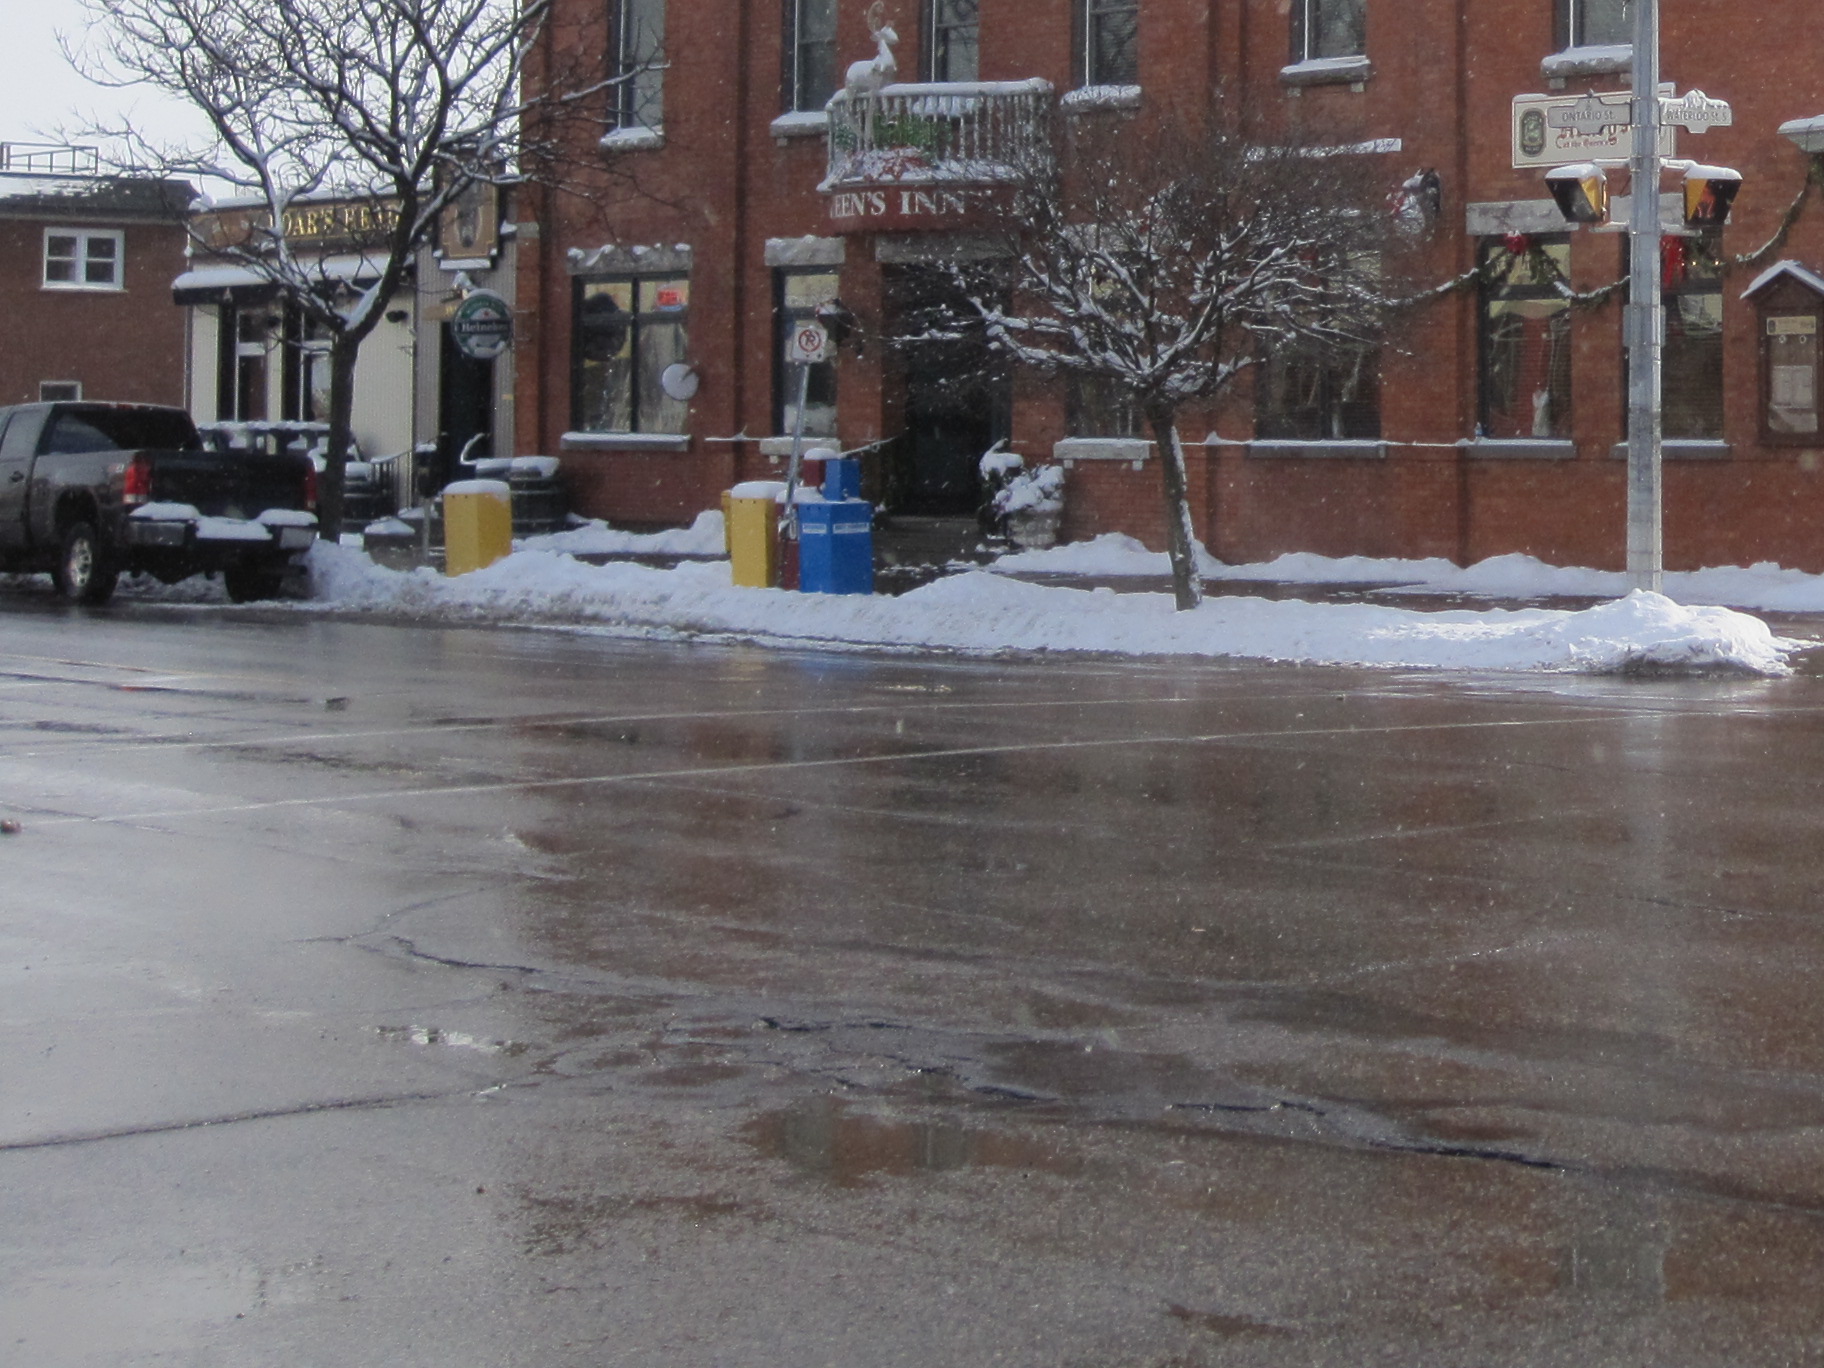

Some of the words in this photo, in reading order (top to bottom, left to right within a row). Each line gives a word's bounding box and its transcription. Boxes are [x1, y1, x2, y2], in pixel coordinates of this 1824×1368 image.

[1561, 110, 1601, 122] ONTARIO
[1666, 109, 1710, 122] WATERLOO
[829, 191, 886, 219] EEN'S
[899, 191, 966, 215] INN
